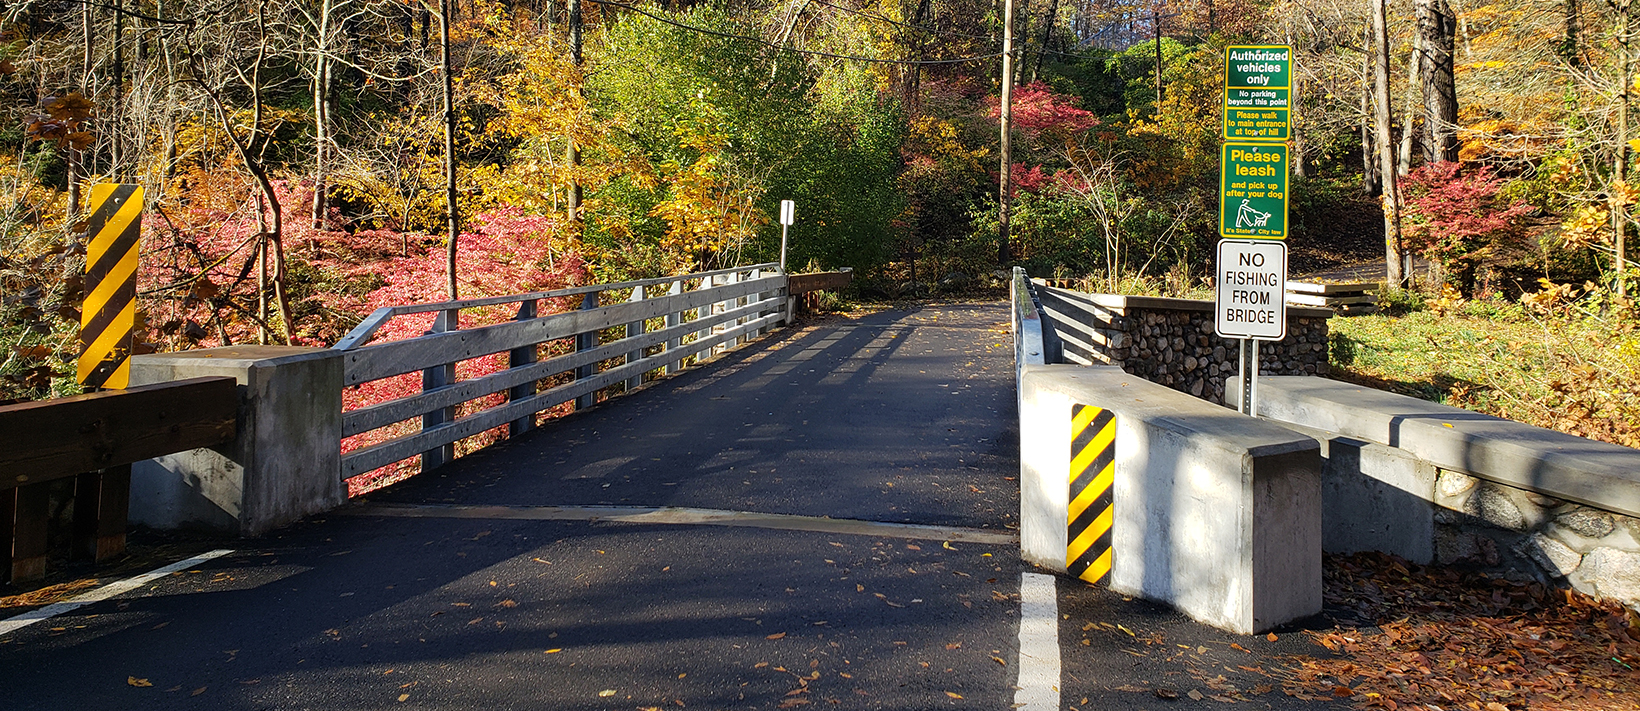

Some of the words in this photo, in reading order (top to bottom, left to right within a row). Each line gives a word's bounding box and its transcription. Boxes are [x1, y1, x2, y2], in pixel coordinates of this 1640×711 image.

[1230, 50, 1288, 61] Authorized
[1237, 62, 1281, 72] vehicles
[1247, 74, 1269, 86] only
[1231, 150, 1280, 162] Please
[1236, 164, 1275, 176] leash
[1239, 253, 1265, 267] NO
[1226, 271, 1277, 286] FISHING
[1232, 290, 1270, 304] FROM
[1227, 308, 1274, 324] BRIDGE
